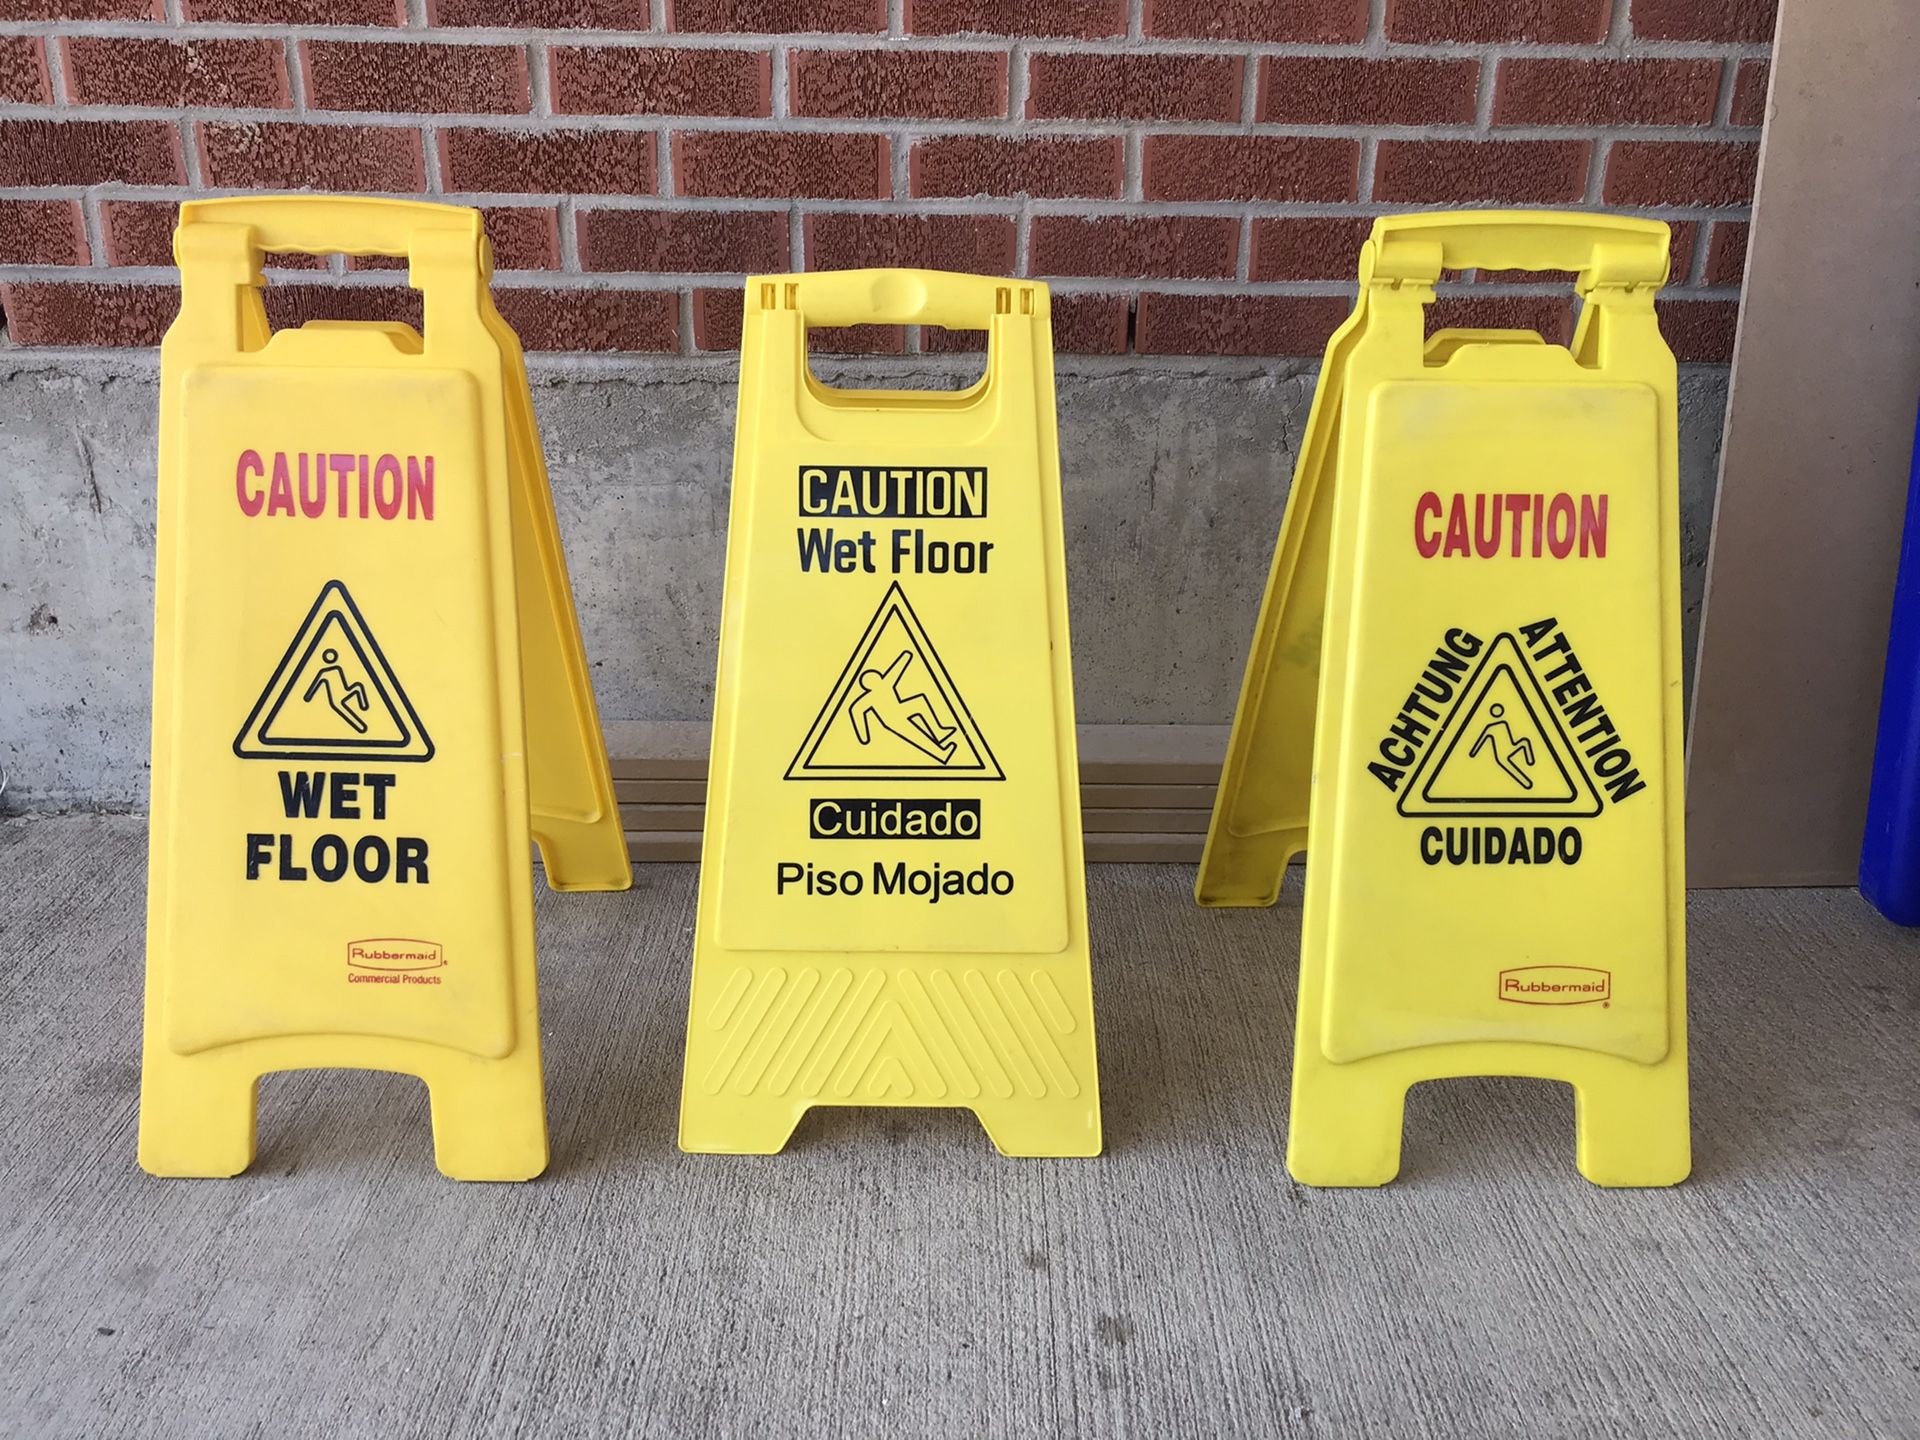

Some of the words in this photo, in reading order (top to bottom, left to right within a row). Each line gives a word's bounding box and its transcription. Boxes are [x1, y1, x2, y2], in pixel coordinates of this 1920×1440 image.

[235, 448, 434, 520] CAUTION
[801, 469, 984, 516] CAUTION
[1414, 491, 1608, 558] CAUTION
[797, 527, 876, 574] Wet
[891, 528, 994, 574] Floor
[1367, 627, 1483, 792] ACHTUNG
[1518, 616, 1647, 804] ATTENTION
[278, 771, 397, 820] WET
[812, 801, 979, 837] Cuidado
[245, 833, 430, 884] FLOOR
[1419, 826, 1582, 865] CUIDADO
[777, 862, 864, 896] Piso
[873, 862, 1015, 904] Mojado
[351, 947, 437, 960] Rubbermaid
[348, 973, 400, 984] Commercial
[402, 974, 441, 985] Products
[1504, 978, 1605, 993] Rubbermaid
